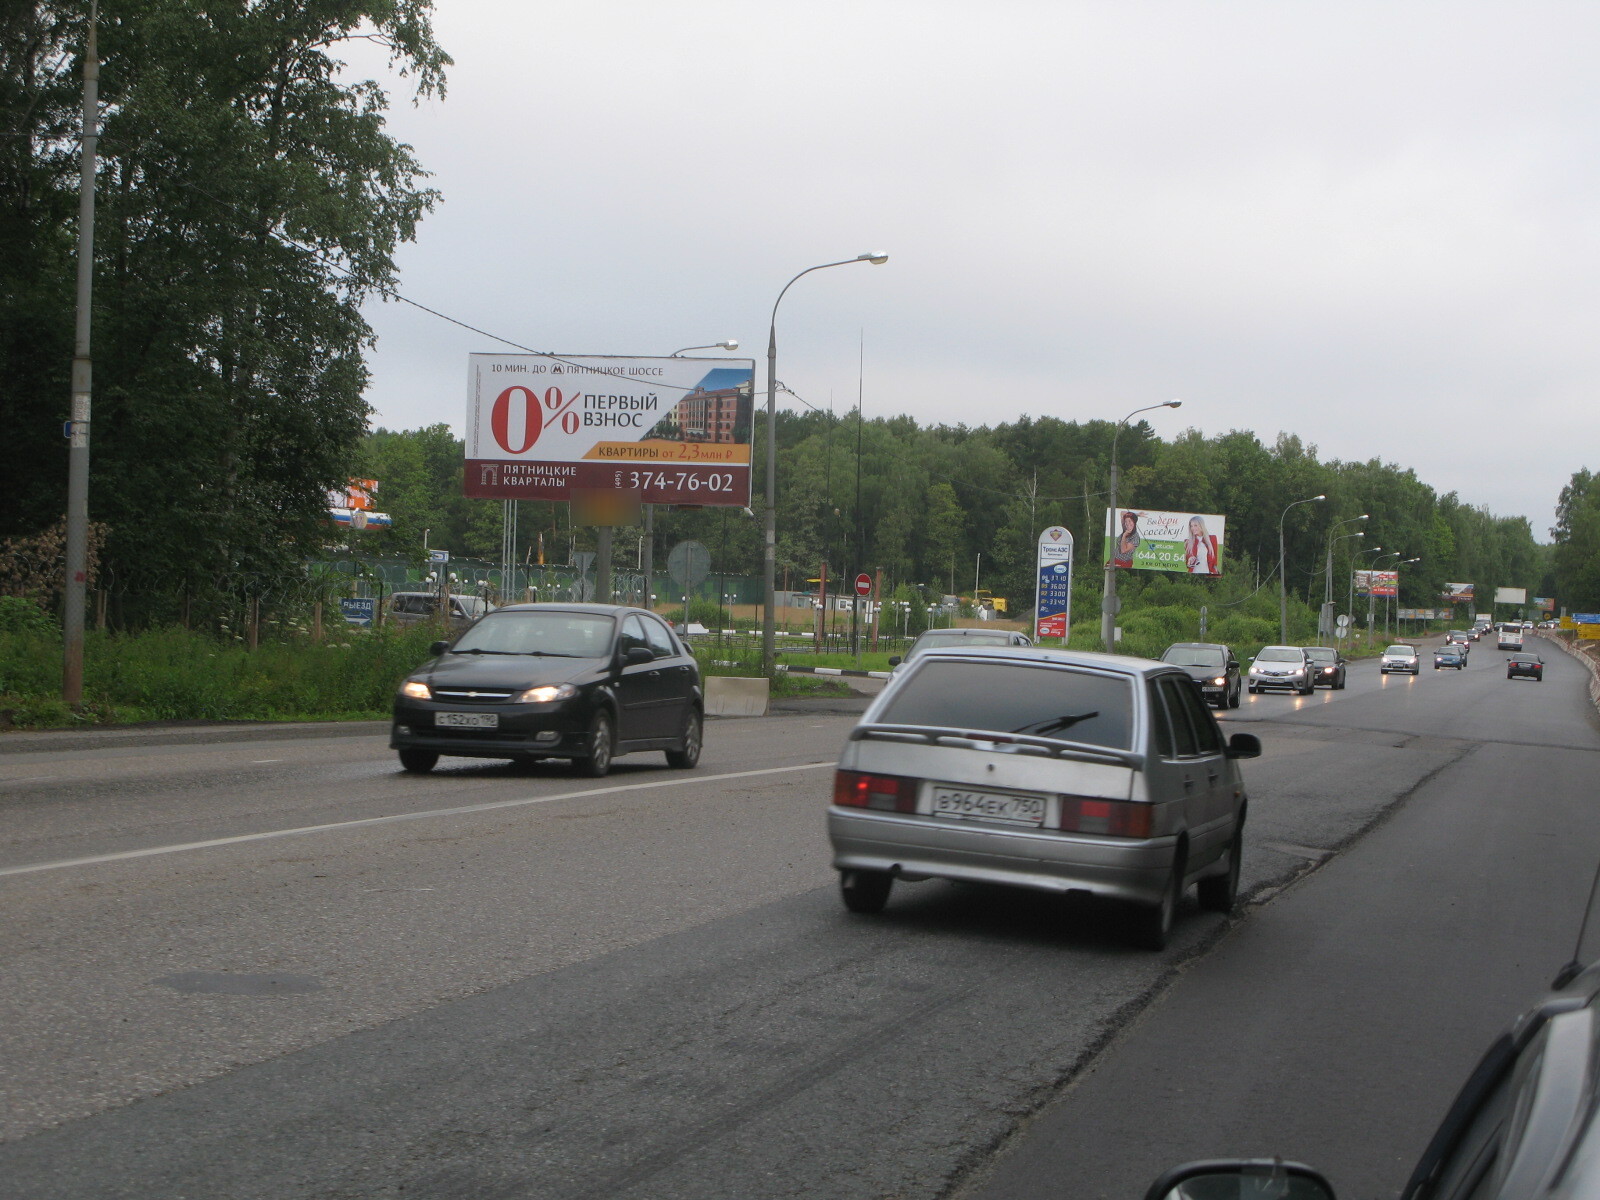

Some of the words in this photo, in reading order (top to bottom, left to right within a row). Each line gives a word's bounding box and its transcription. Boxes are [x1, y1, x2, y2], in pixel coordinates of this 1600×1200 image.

[491, 364, 502, 373] 10
[504, 364, 530, 373] МИН.
[533, 365, 547, 374] ДО
[567, 365, 625, 376] ПЯТНИЦКОЕ
[628, 367, 663, 376] ШОССЕ
[584, 393, 658, 410] ПЕРВЫЙ
[491, 385, 581, 455] 0%
[584, 412, 643, 427] ВЗНОС
[598, 446, 659, 458] КВАРТИРЫ
[662, 450, 675, 458] от
[503, 464, 577, 476] ПЯТНИЦКИЕ
[503, 476, 565, 487] КВАРТАЛЫ
[630, 472, 733, 491] 374-76-02
[1138, 551, 1156, 560] 644
[1159, 552, 1171, 561] 20
[1173, 553, 1185, 562] 54
[343, 601, 371, 610] ВЫЕЗД
